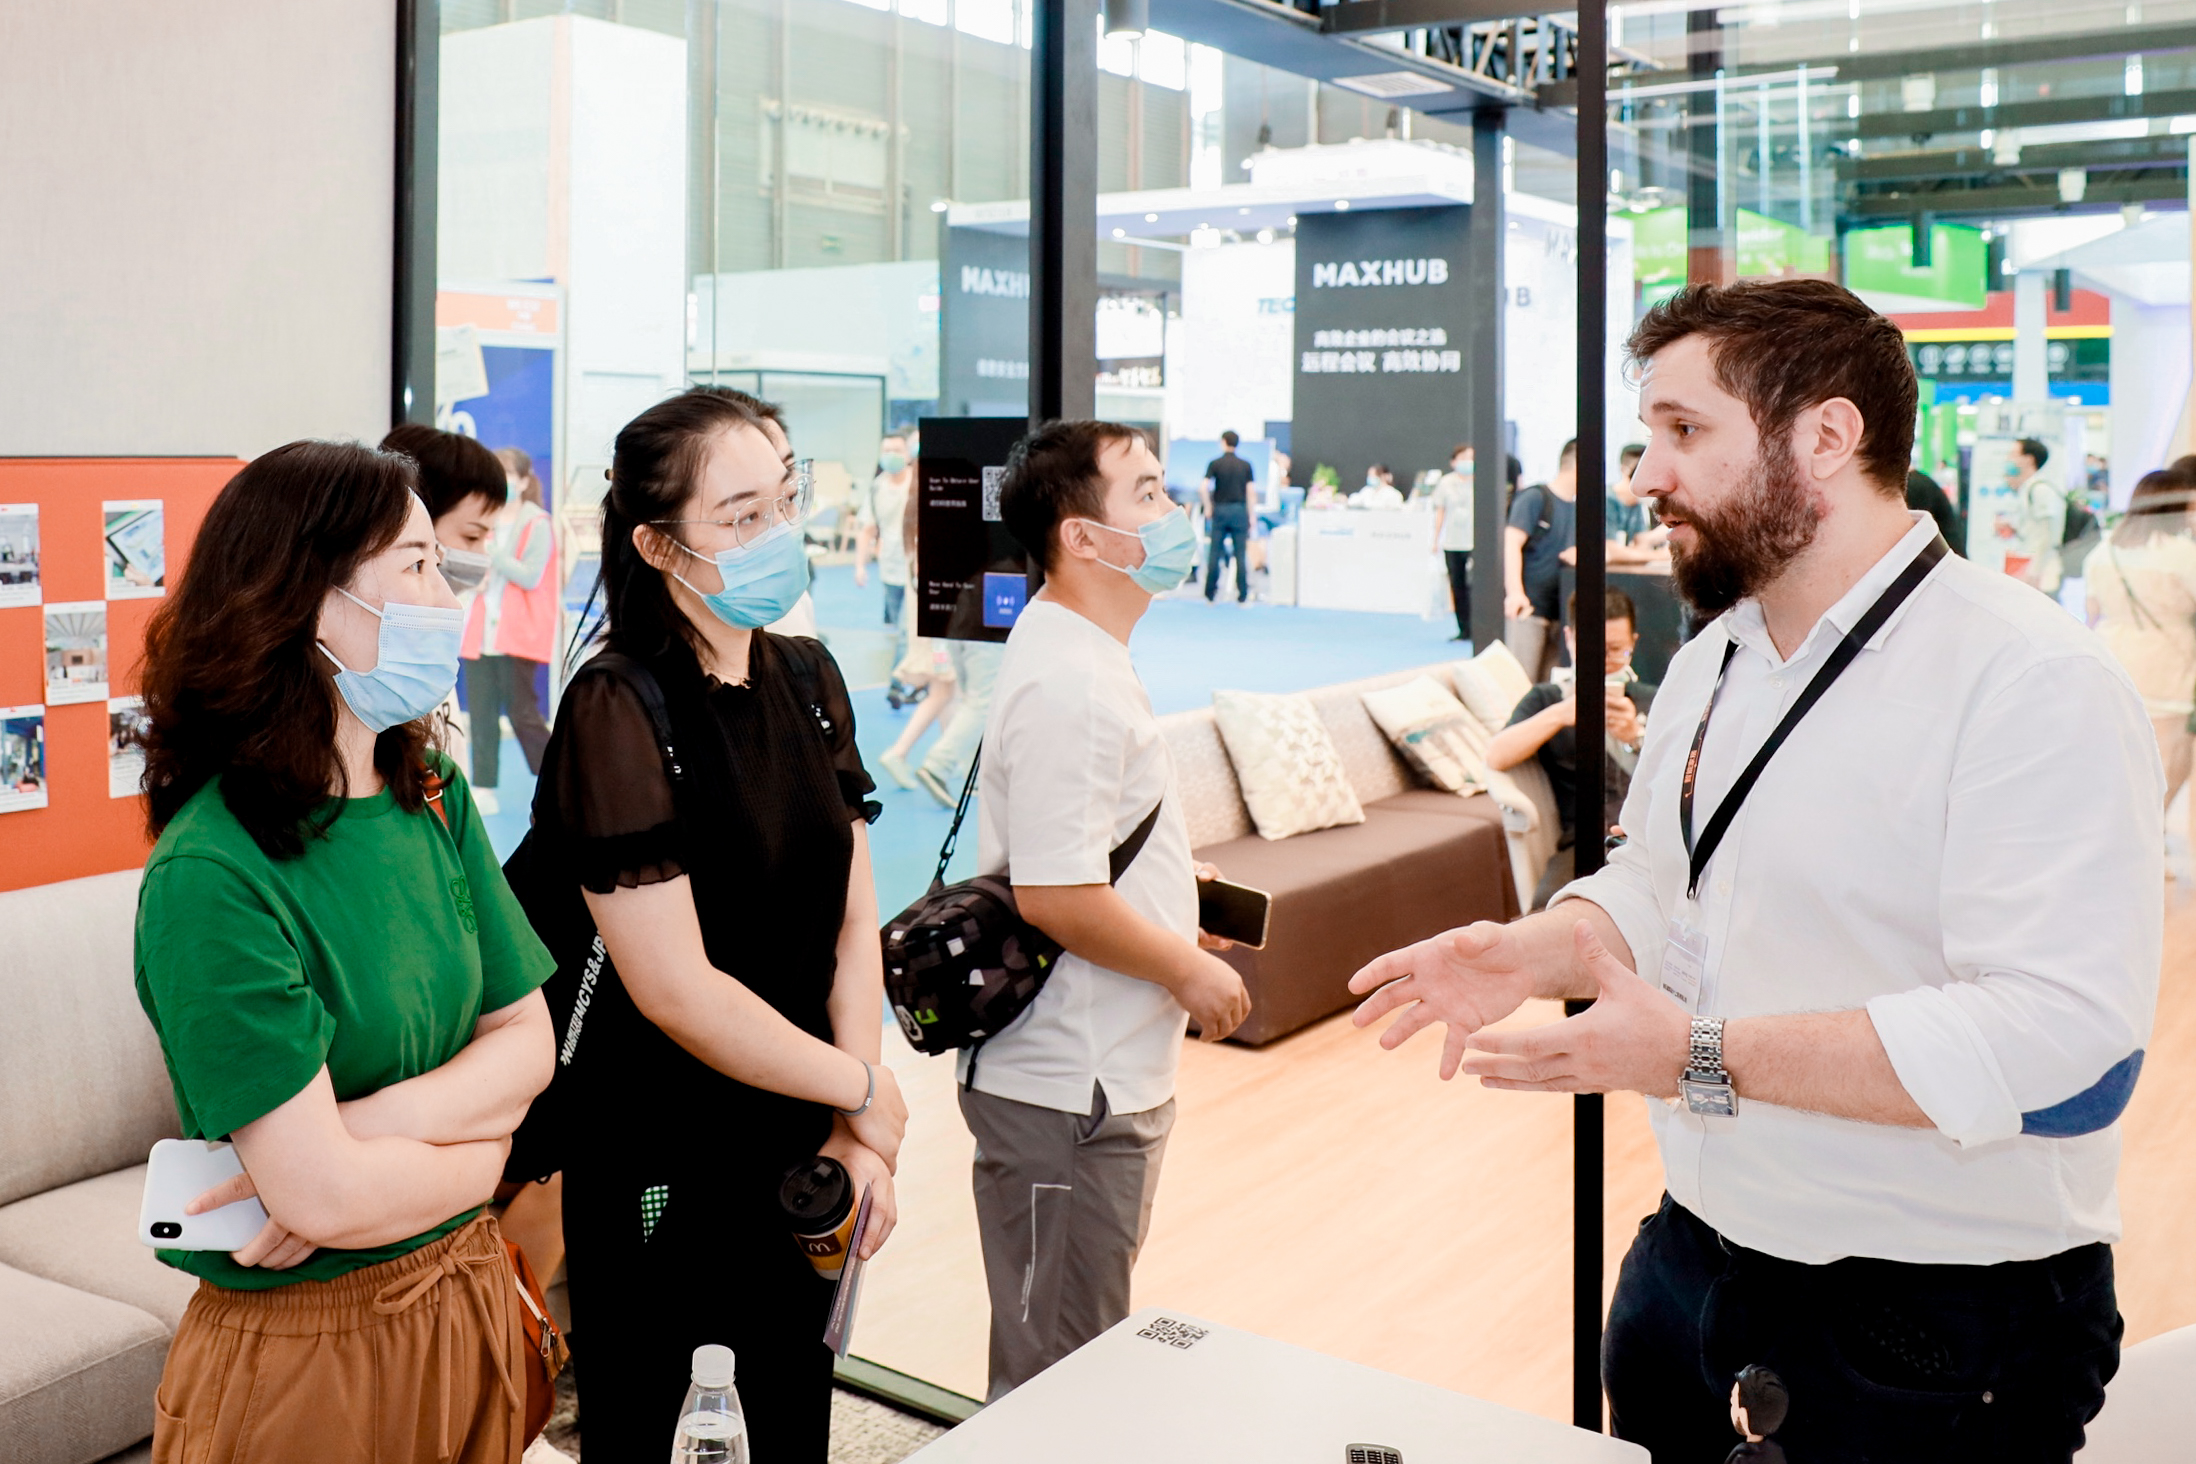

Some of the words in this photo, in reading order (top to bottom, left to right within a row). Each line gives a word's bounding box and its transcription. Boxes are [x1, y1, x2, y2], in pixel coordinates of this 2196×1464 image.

[1313, 258, 1449, 288] MAXHUB
[1301, 351, 1377, 373] 远程会议
[1382, 349, 1461, 373] 高效协同
[574, 930, 607, 1019] MCYS&JP
